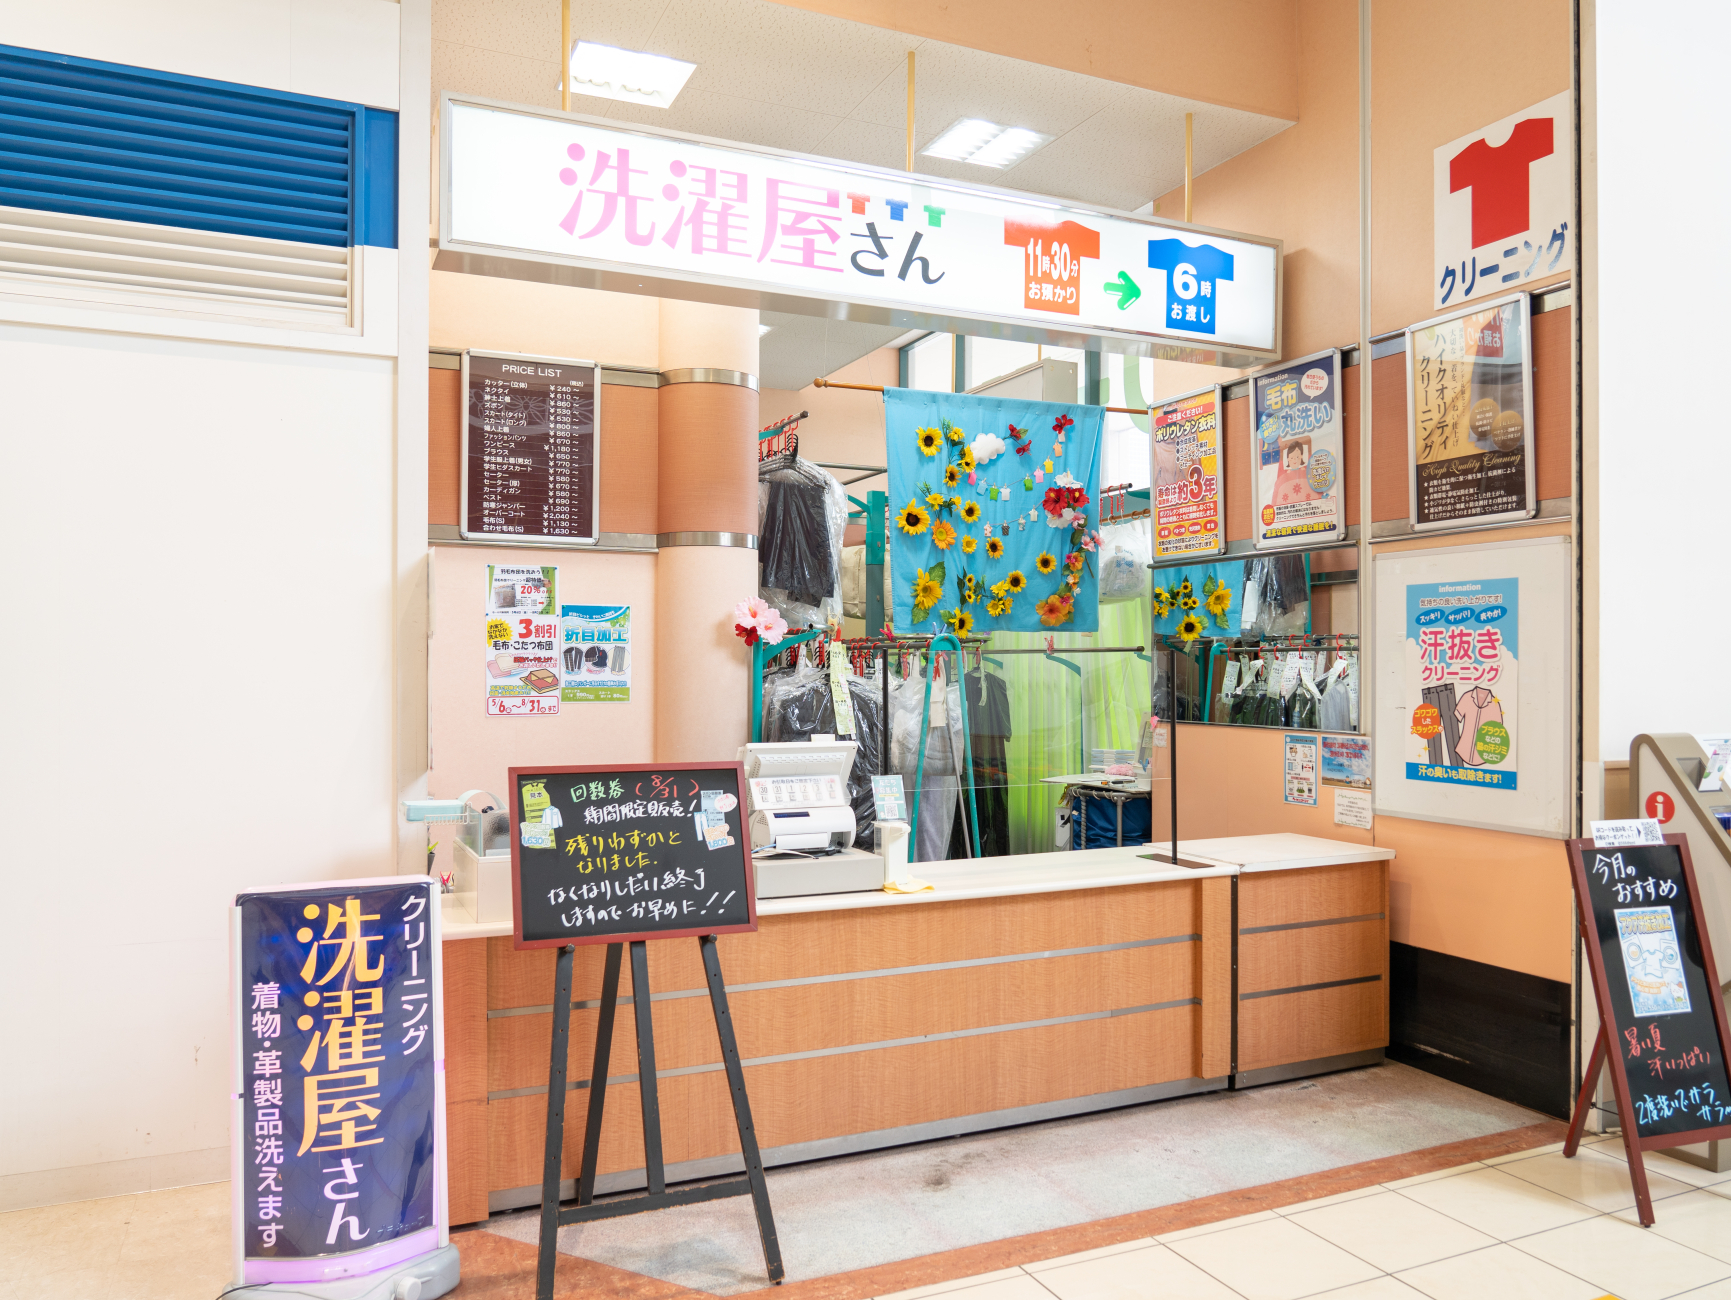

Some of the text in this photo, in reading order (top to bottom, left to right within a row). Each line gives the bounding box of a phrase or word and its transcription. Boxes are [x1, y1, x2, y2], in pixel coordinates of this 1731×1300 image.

[558, 142, 945, 285] 洗濯屋さん
[1025, 236, 1079, 281] 11時30分
[1440, 221, 1568, 305] クリーニング
[1171, 261, 1212, 297] 6時
[1027, 280, 1078, 307] お預かり
[1170, 301, 1211, 324] お渡し
[502, 364, 562, 377] PRICE LIST
[1257, 373, 1288, 387] information
[1266, 382, 1297, 410] 毛布
[1434, 333, 1449, 450] ハイクオリティ
[1281, 404, 1329, 435] 丸洗い
[1420, 355, 1435, 460] クリーニング
[1156, 412, 1216, 442] ポリウレタン衣料
[484, 440, 515, 448] ワンピース
[484, 448, 509, 456] ブラウス
[1422, 453, 1521, 478] High Quality Cleaning
[483, 486, 520, 494] カーディガン
[482, 510, 526, 518] オーバーコート
[520, 586, 541, 594] 20%
[1438, 583, 1482, 593] information
[1420, 594, 1503, 608] 気持ちの良い洗い上がりです!
[1420, 608, 1502, 624] スッキリ サッパリ 爽やか!
[518, 618, 557, 639] 3割引
[563, 625, 629, 644] 折目加工
[492, 640, 554, 650] 毛布・こたつ布団
[1420, 628, 1500, 662] 汗抜き
[1421, 665, 1501, 682] クリーニング
[1414, 708, 1438, 718] ゴワゴワ
[1410, 724, 1444, 735] スラックスや
[1481, 725, 1506, 737] ブラウス
[1485, 735, 1501, 744] などの
[1418, 765, 1502, 784] 汗の臭いも取除きます!
[570, 778, 624, 802] 回数券
[565, 830, 683, 856] 残りわずかと
[1592, 852, 1636, 884] 今月の
[547, 867, 706, 906] なくなりしだい終了
[1612, 876, 1678, 904] おすすめ
[561, 904, 622, 928] しますので
[401, 895, 428, 1056] クリーニング
[296, 899, 386, 1245] 洗濯屋さん
[1647, 1046, 1710, 1080] 汗いっぱい
[251, 981, 284, 1248] 着物・革製品洗えます
